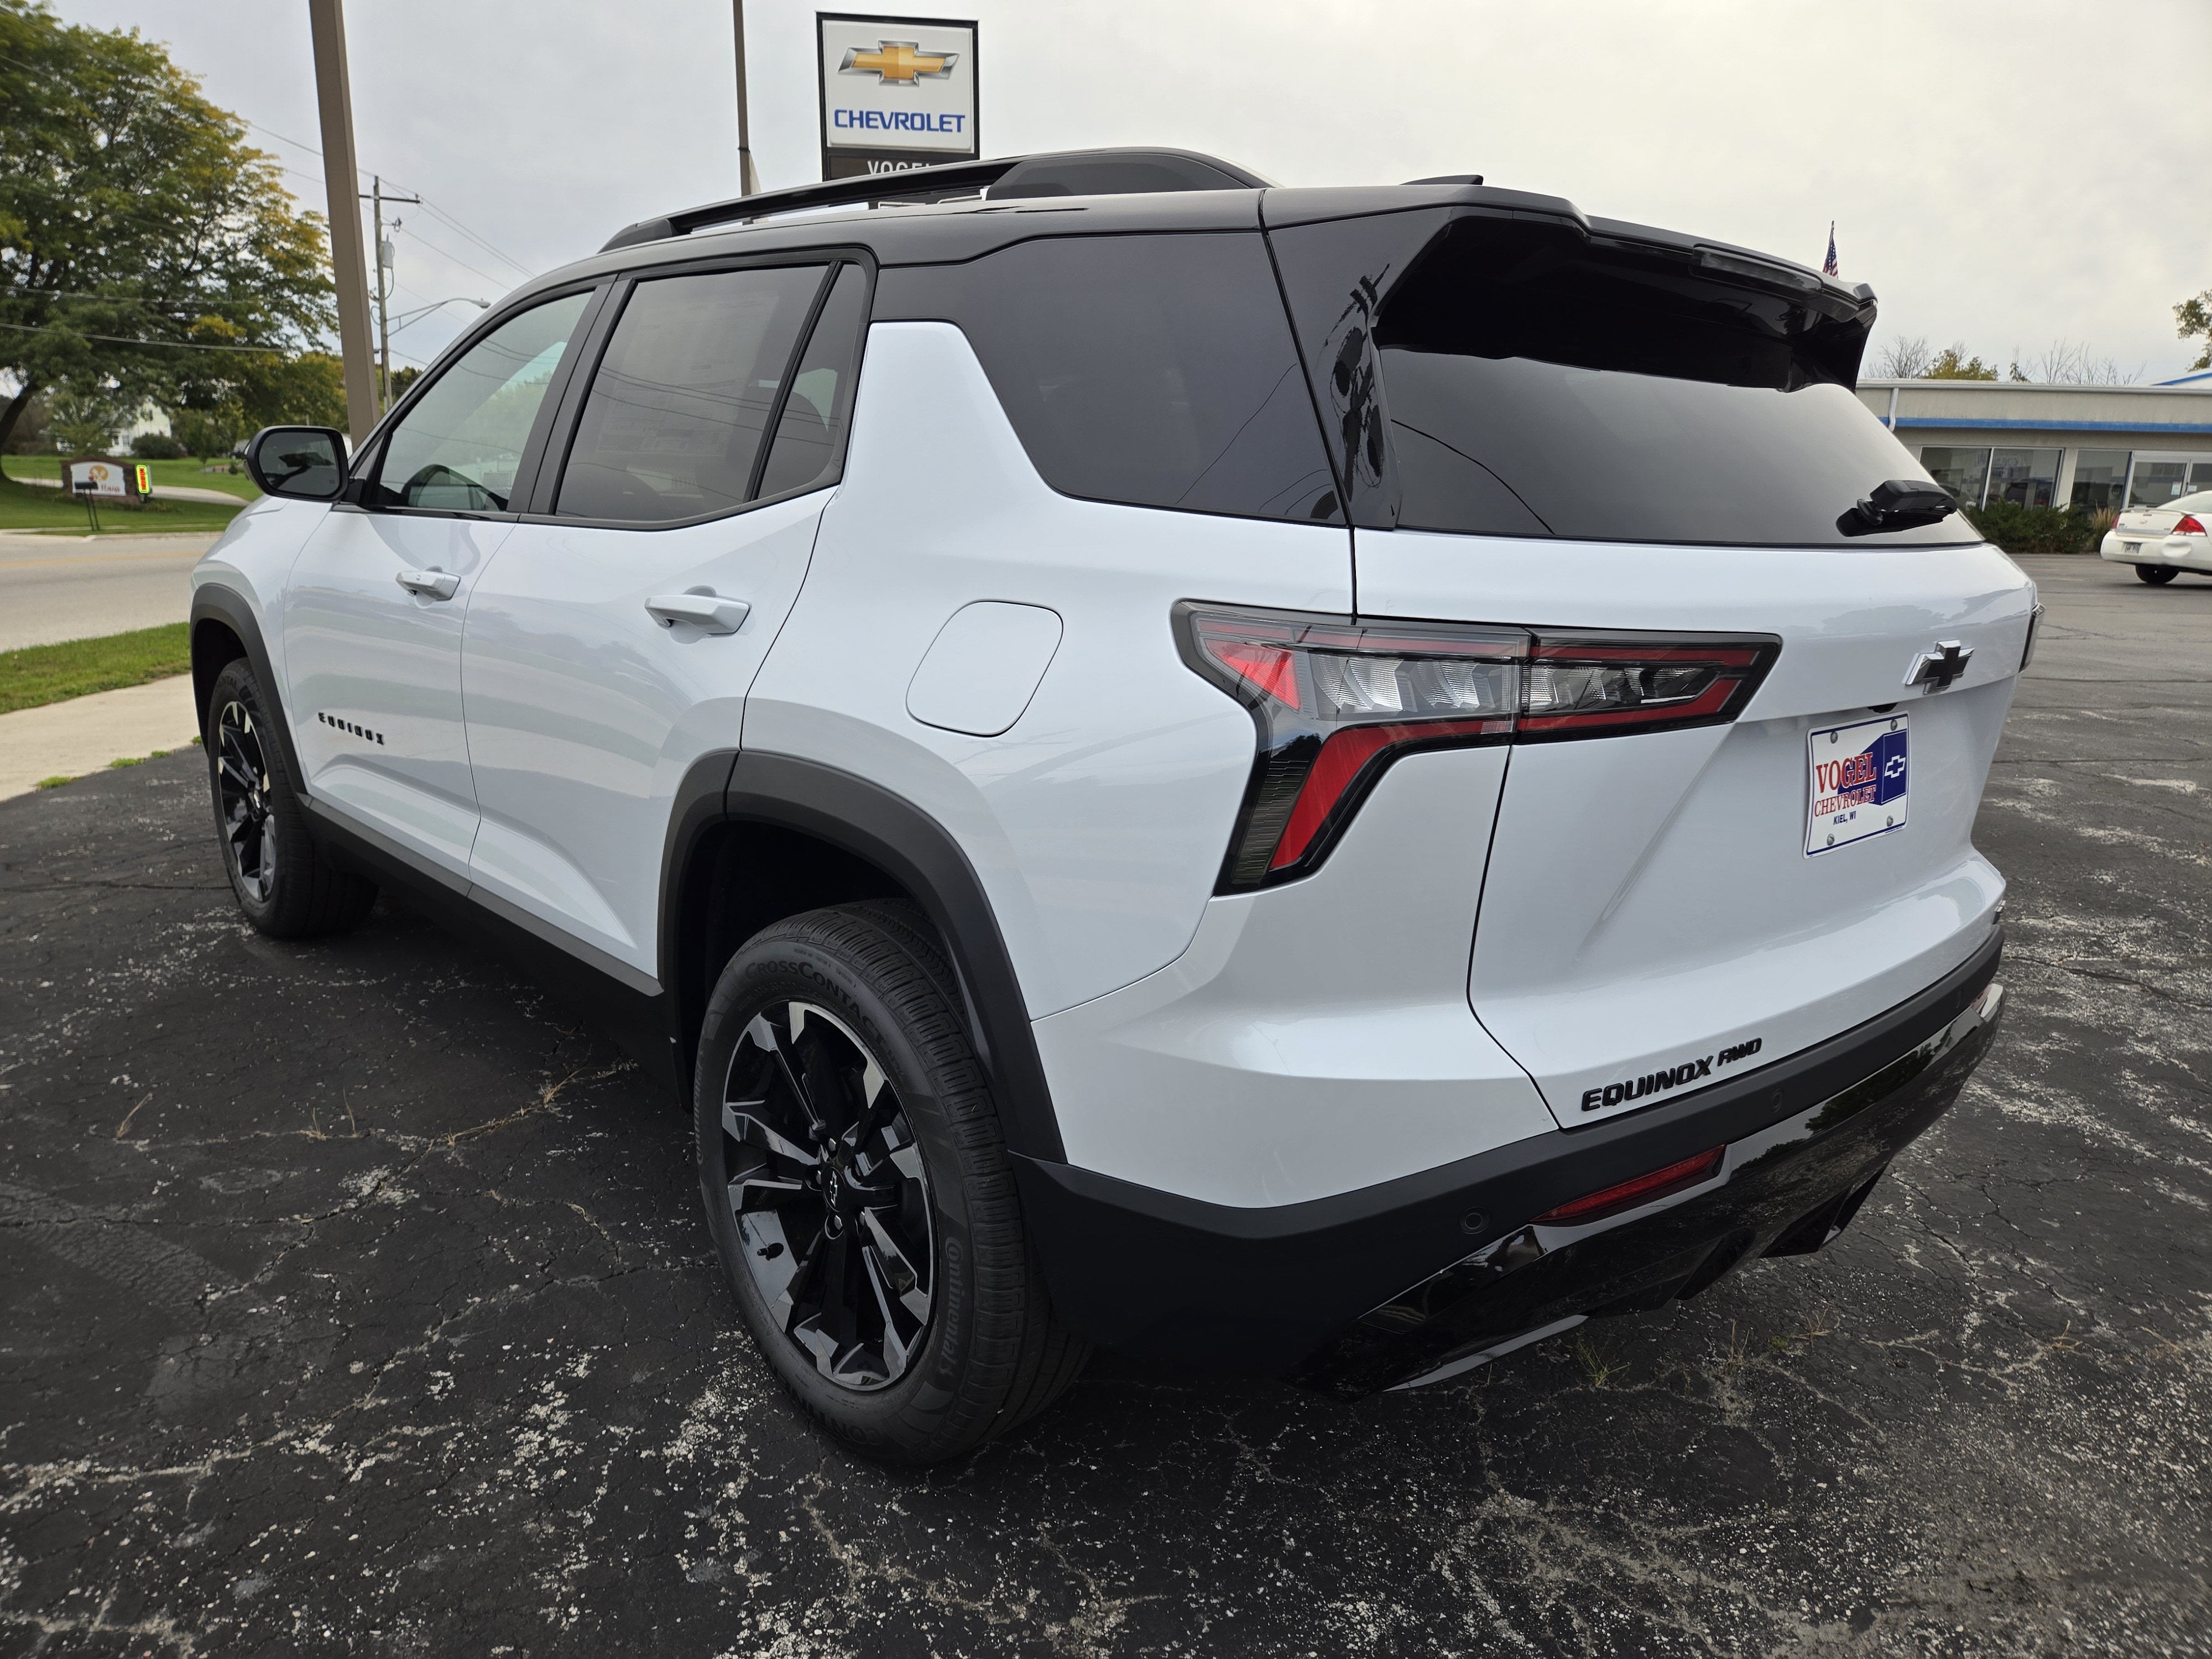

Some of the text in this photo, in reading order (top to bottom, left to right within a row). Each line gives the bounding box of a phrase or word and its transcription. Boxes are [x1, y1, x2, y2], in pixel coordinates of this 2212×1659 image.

[834, 109, 966, 133] CHEVROLET
[318, 711, 385, 745] EQUINOX
[1815, 752, 1876, 794] VOGEL
[1814, 784, 1876, 817] CHEVROLET
[1849, 811, 1856, 820] WI
[1581, 1037, 1762, 1112] EQUINOX AWD
[941, 1236, 966, 1365] Continental
